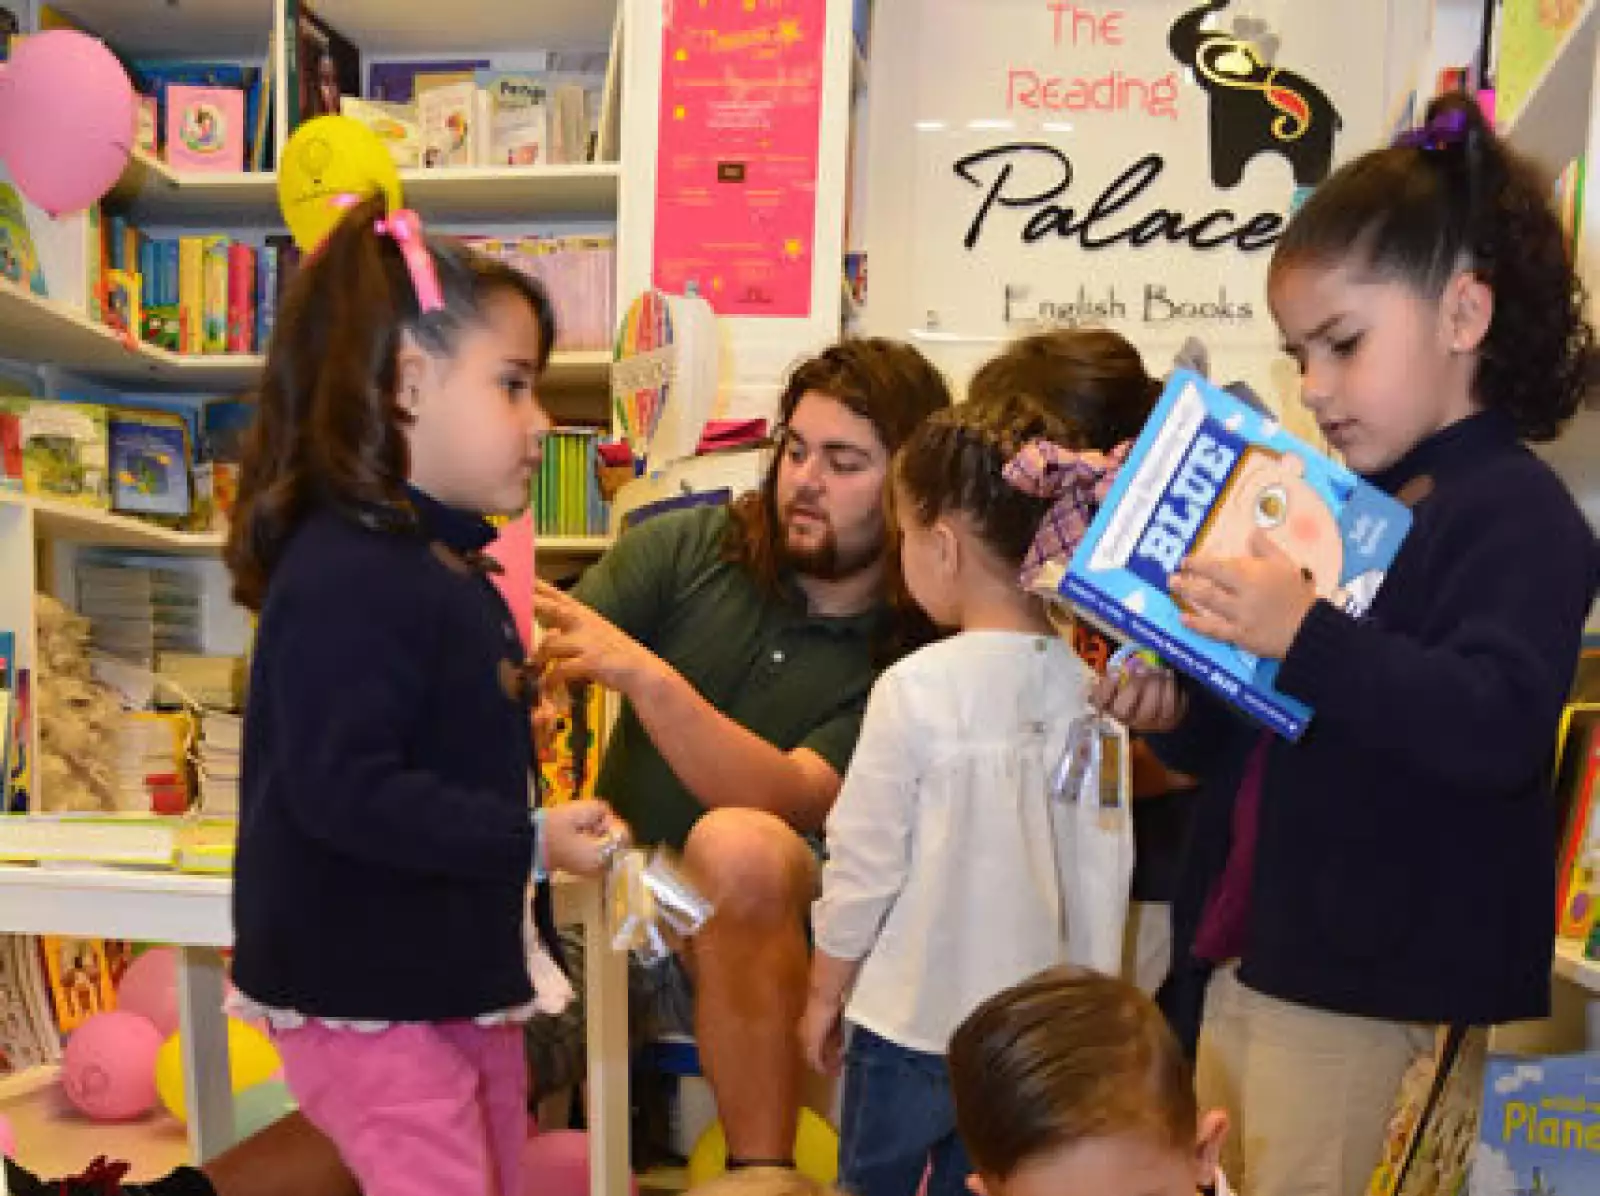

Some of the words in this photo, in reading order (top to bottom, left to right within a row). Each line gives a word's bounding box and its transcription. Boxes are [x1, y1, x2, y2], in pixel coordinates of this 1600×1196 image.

[1046, 3, 1127, 46] The
[1004, 68, 1179, 120] Reading
[952, 142, 1284, 250] Palace
[1002, 284, 1127, 327] English
[1143, 284, 1254, 322] Books
[1135, 433, 1238, 572] BLUE
